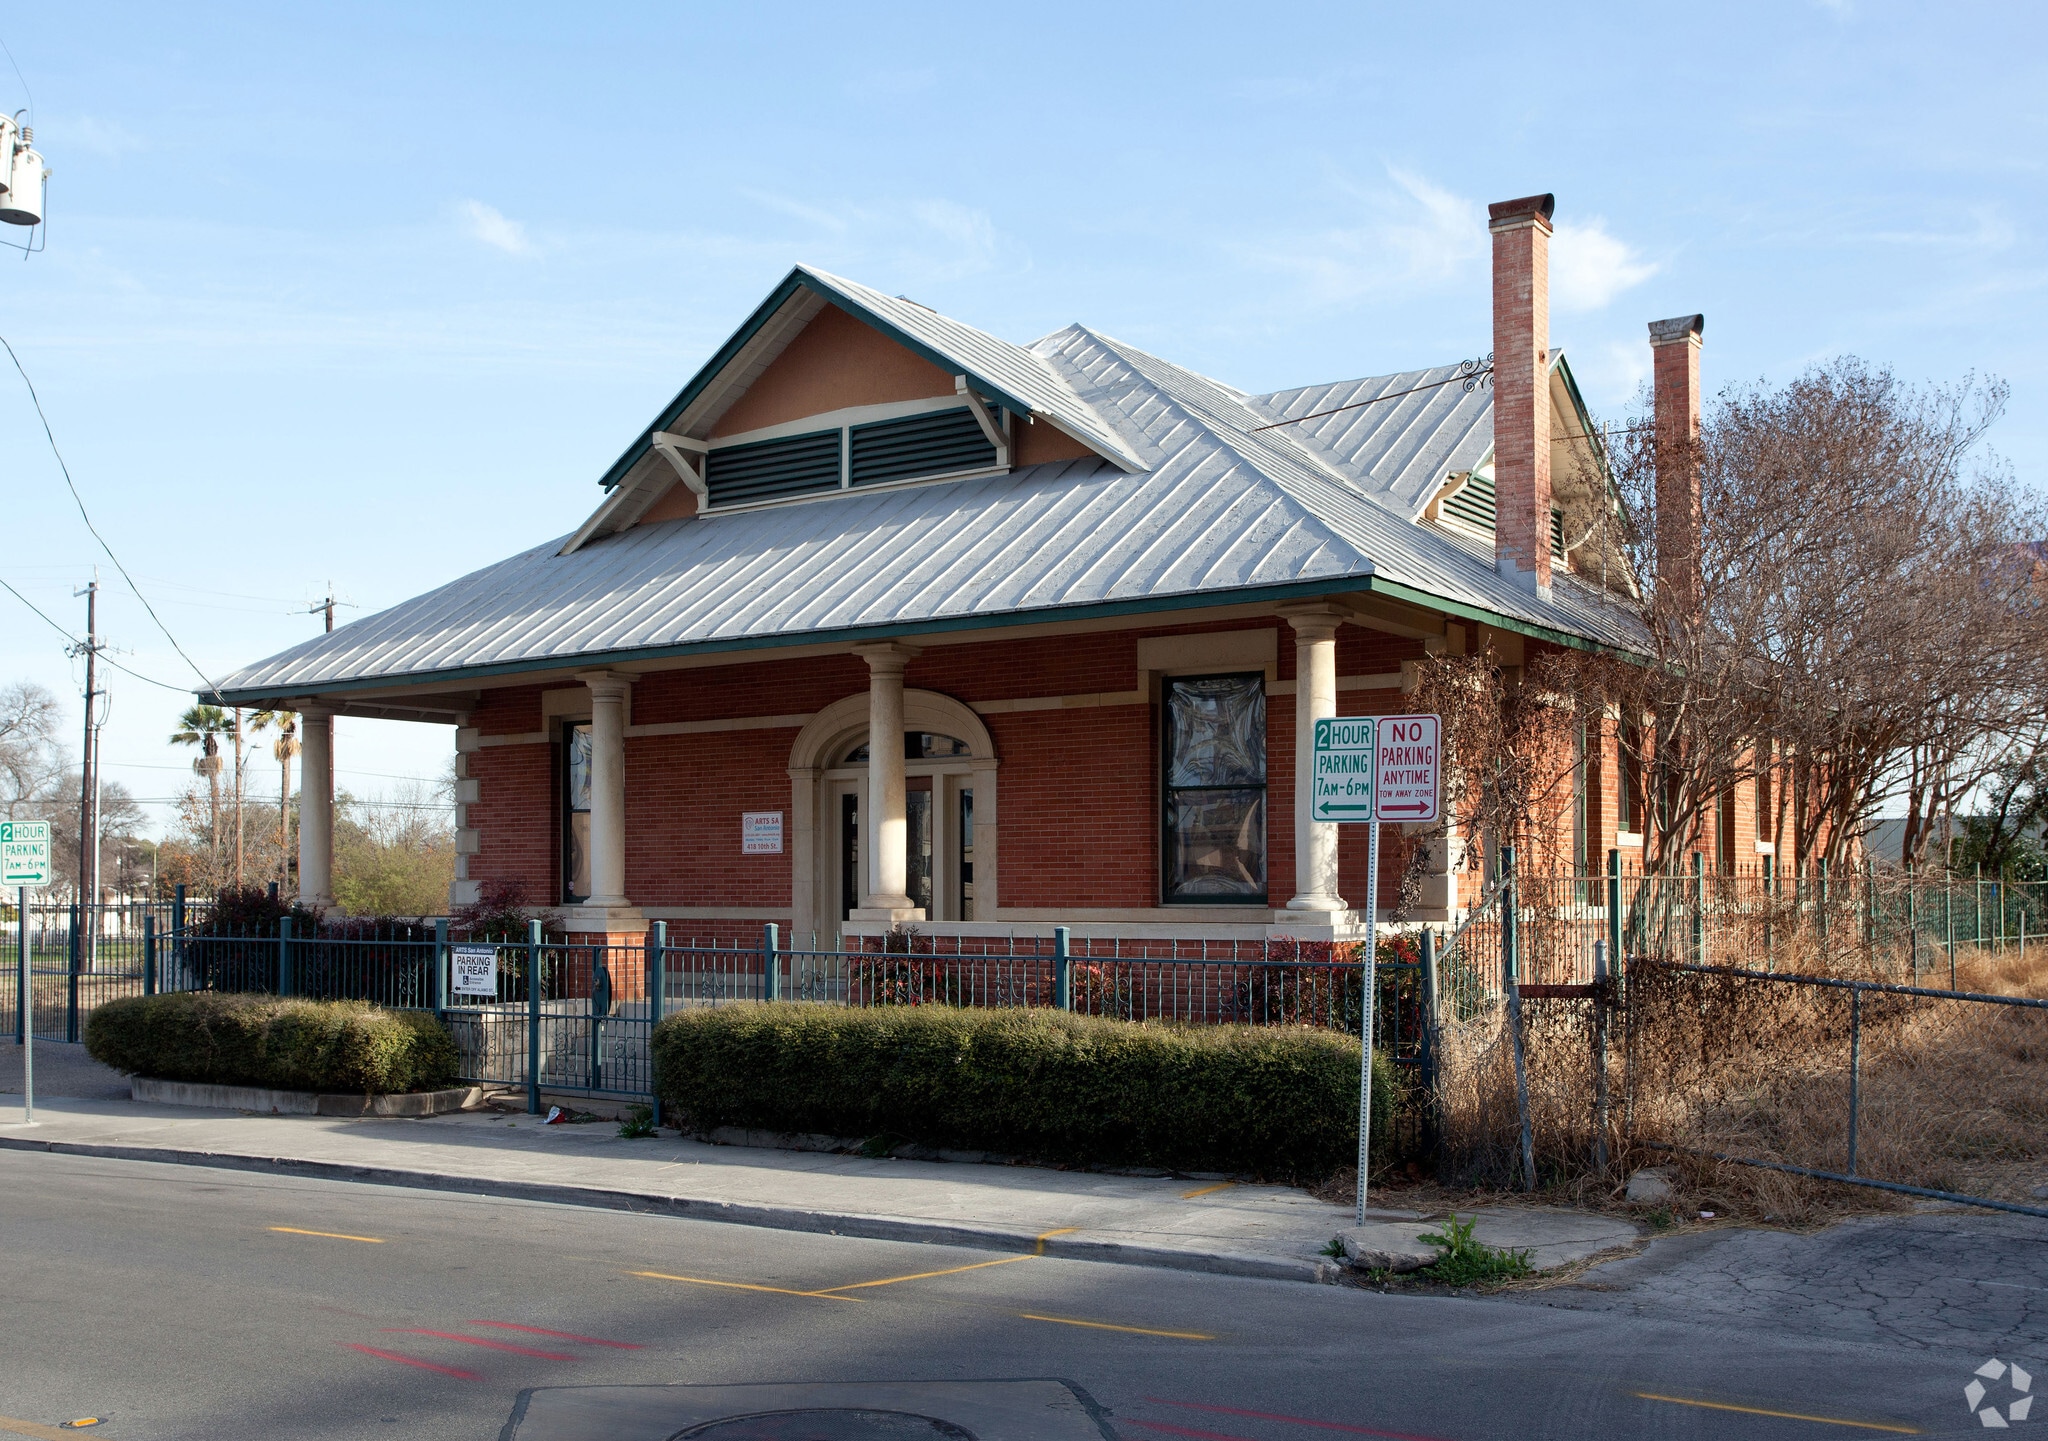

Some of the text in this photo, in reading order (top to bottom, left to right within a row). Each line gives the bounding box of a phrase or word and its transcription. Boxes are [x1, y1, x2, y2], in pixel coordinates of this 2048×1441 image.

[1317, 724, 1370, 748] 2 HOUR
[1392, 722, 1423, 742] NO
[1381, 746, 1432, 766] PARKING
[1319, 754, 1368, 774] PARKING
[1383, 769, 1430, 785] ANYTIME
[1317, 777, 1369, 796] 7AM-6PM
[1379, 789, 1434, 798] TOW AWAY ZONE
[2, 825, 45, 840] 2 HOUR
[5, 844, 44, 856] PARKING
[4, 858, 46, 870] 7AM-6PM
[456, 955, 491, 966] PARKING
[458, 966, 489, 975] IN REAR
